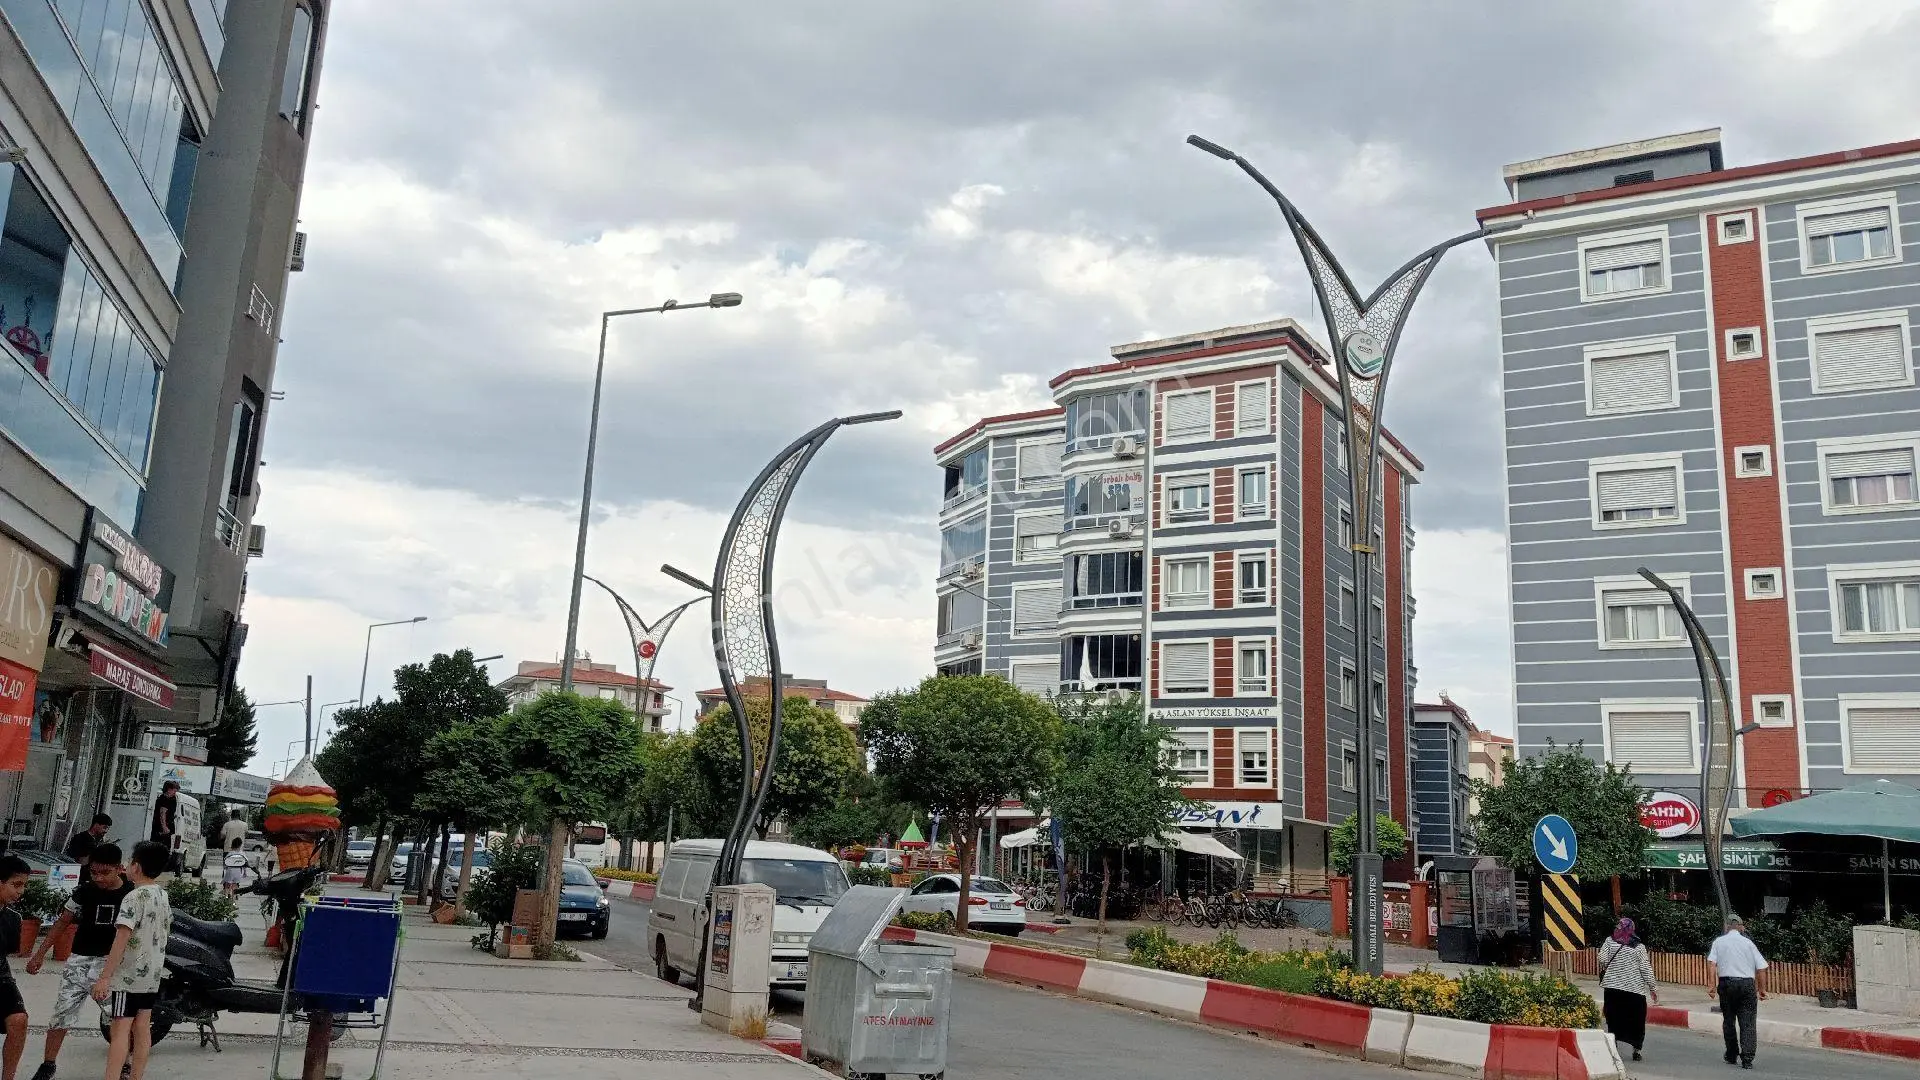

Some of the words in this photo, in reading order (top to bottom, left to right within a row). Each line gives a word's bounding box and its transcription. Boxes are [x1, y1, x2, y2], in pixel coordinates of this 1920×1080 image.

[83, 563, 169, 648] DONDURMA
[106, 662, 131, 691] MARAŞ
[131, 674, 162, 701] DONDURMA
[1166, 709, 1195, 718] ASLAN
[1197, 707, 1233, 717] YÜKSEL
[1235, 707, 1269, 718] İNŞAAT
[1653, 818, 1673, 826] simit
[1723, 851, 1761, 866] SİMİT
[1767, 854, 1791, 866] Jet
[1368, 874, 1377, 922] BELEDİYESİ
[1369, 923, 1377, 962] TORBALI
[888, 1015, 936, 1026] ATMAYINIZ
